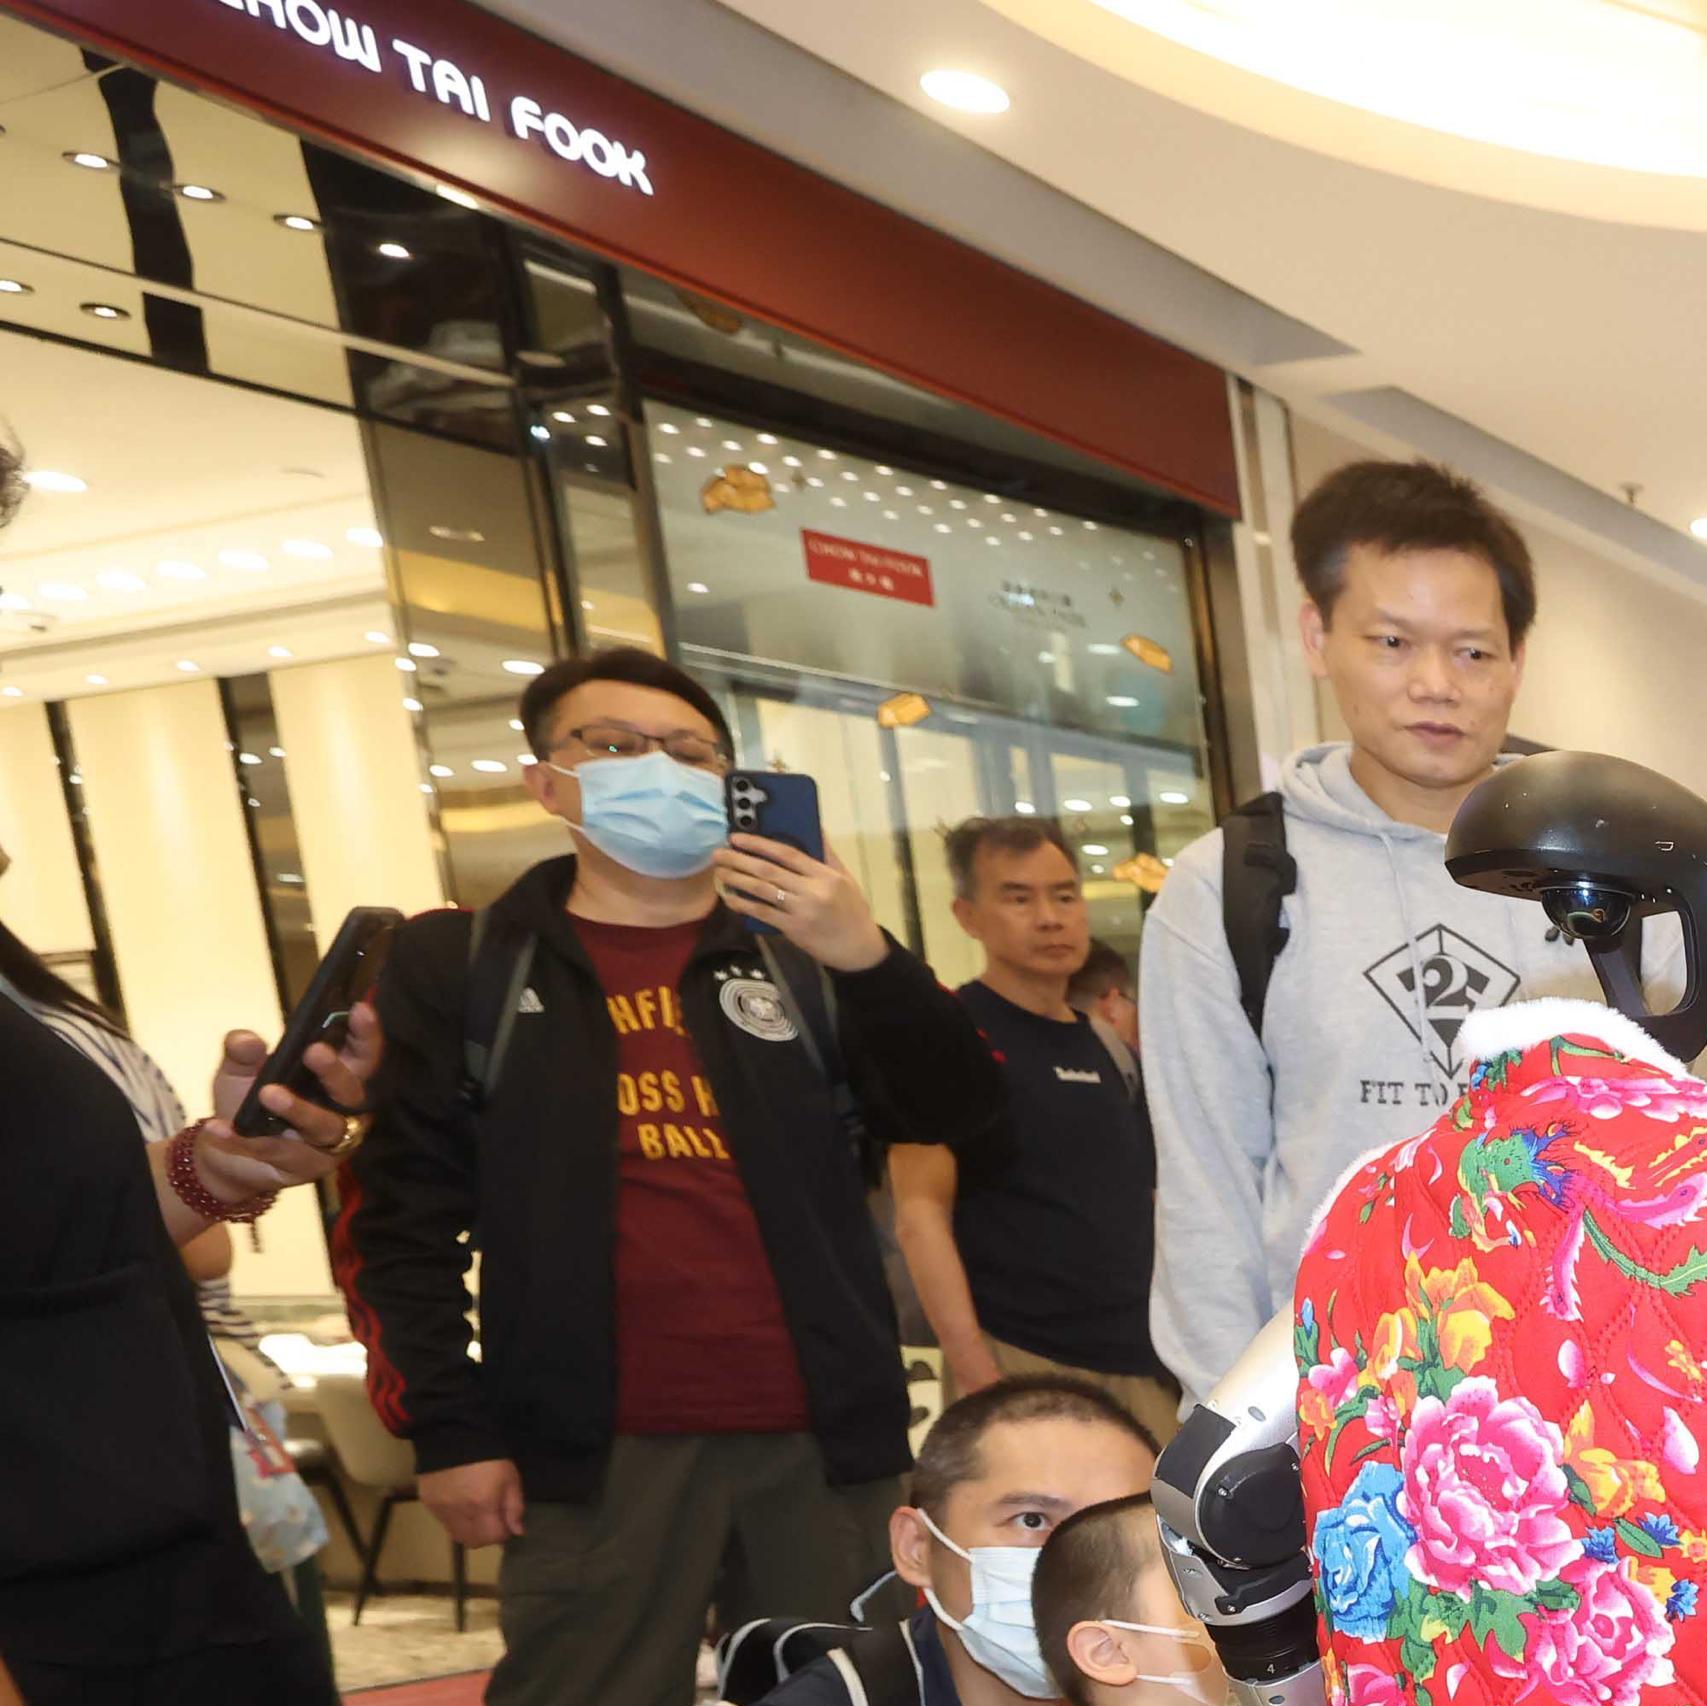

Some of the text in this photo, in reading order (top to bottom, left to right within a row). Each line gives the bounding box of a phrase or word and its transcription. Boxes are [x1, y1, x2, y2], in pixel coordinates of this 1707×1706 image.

[218, 0, 654, 195] HOW TAI FOOK
[606, 986, 686, 1036] HFI
[1360, 1079, 1404, 1105] FIT
[1266, 1663, 1275, 1674] 4
